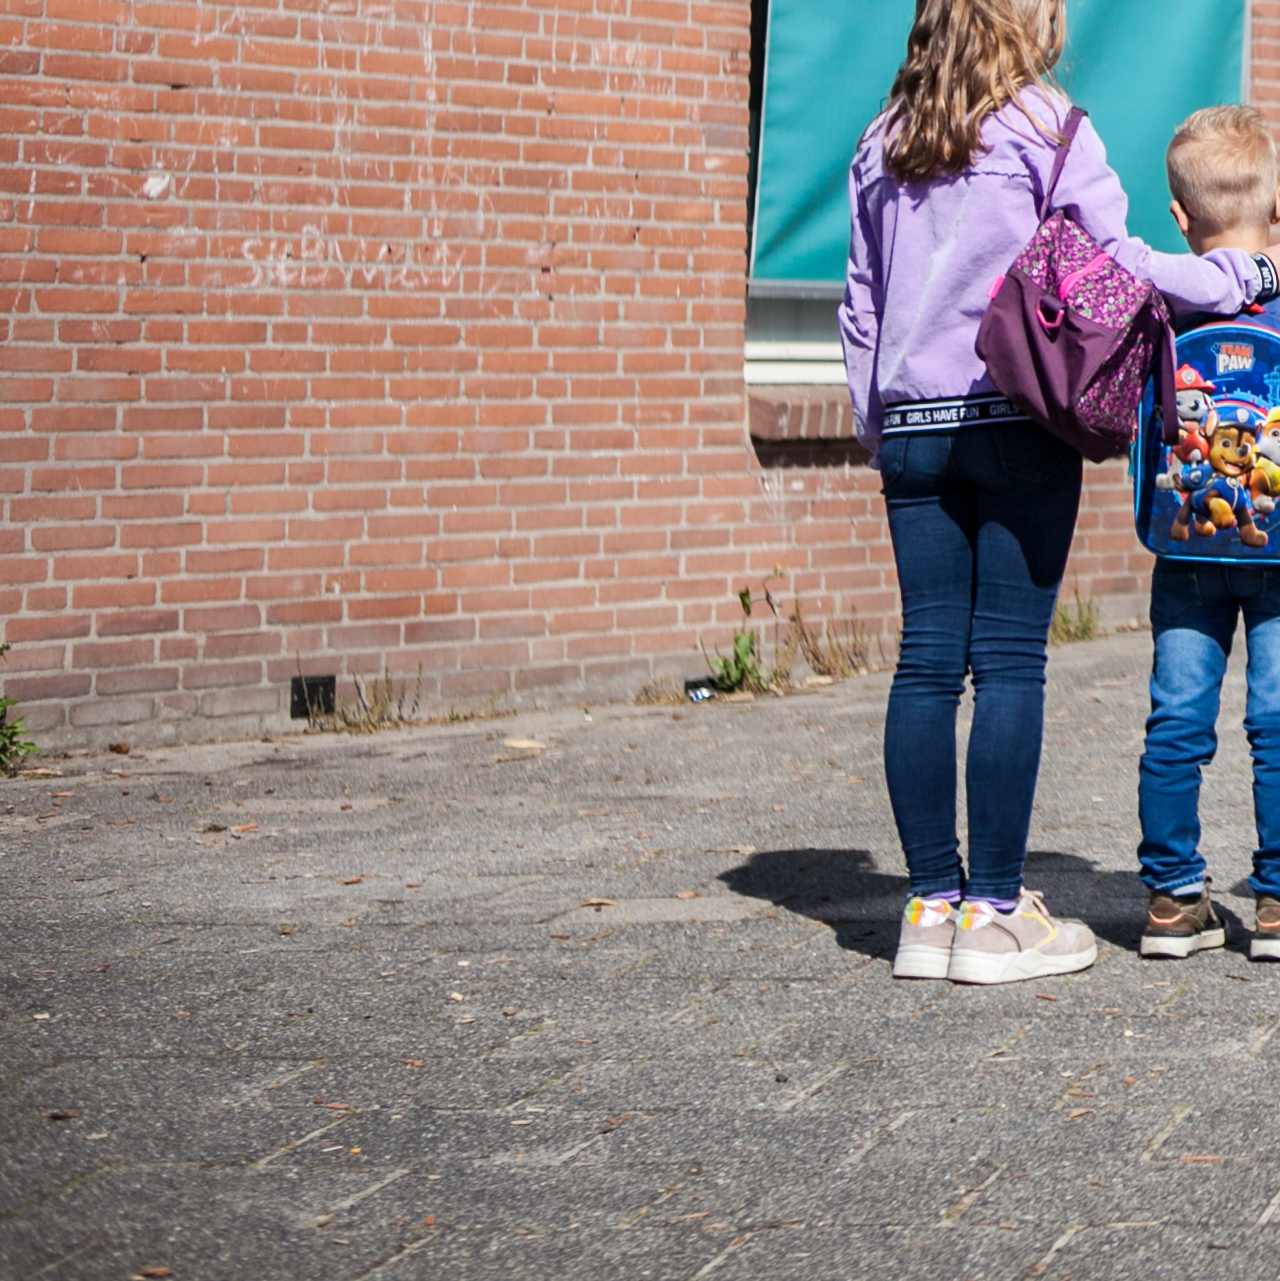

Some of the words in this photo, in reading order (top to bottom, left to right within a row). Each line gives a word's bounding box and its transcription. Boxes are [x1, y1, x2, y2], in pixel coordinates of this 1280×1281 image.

[1218, 353, 1253, 373] PAW
[906, 410, 932, 424] GIRLS
[933, 407, 958, 421] HAVE
[960, 406, 979, 419] FUN
[989, 402, 1020, 416] GIRLS
